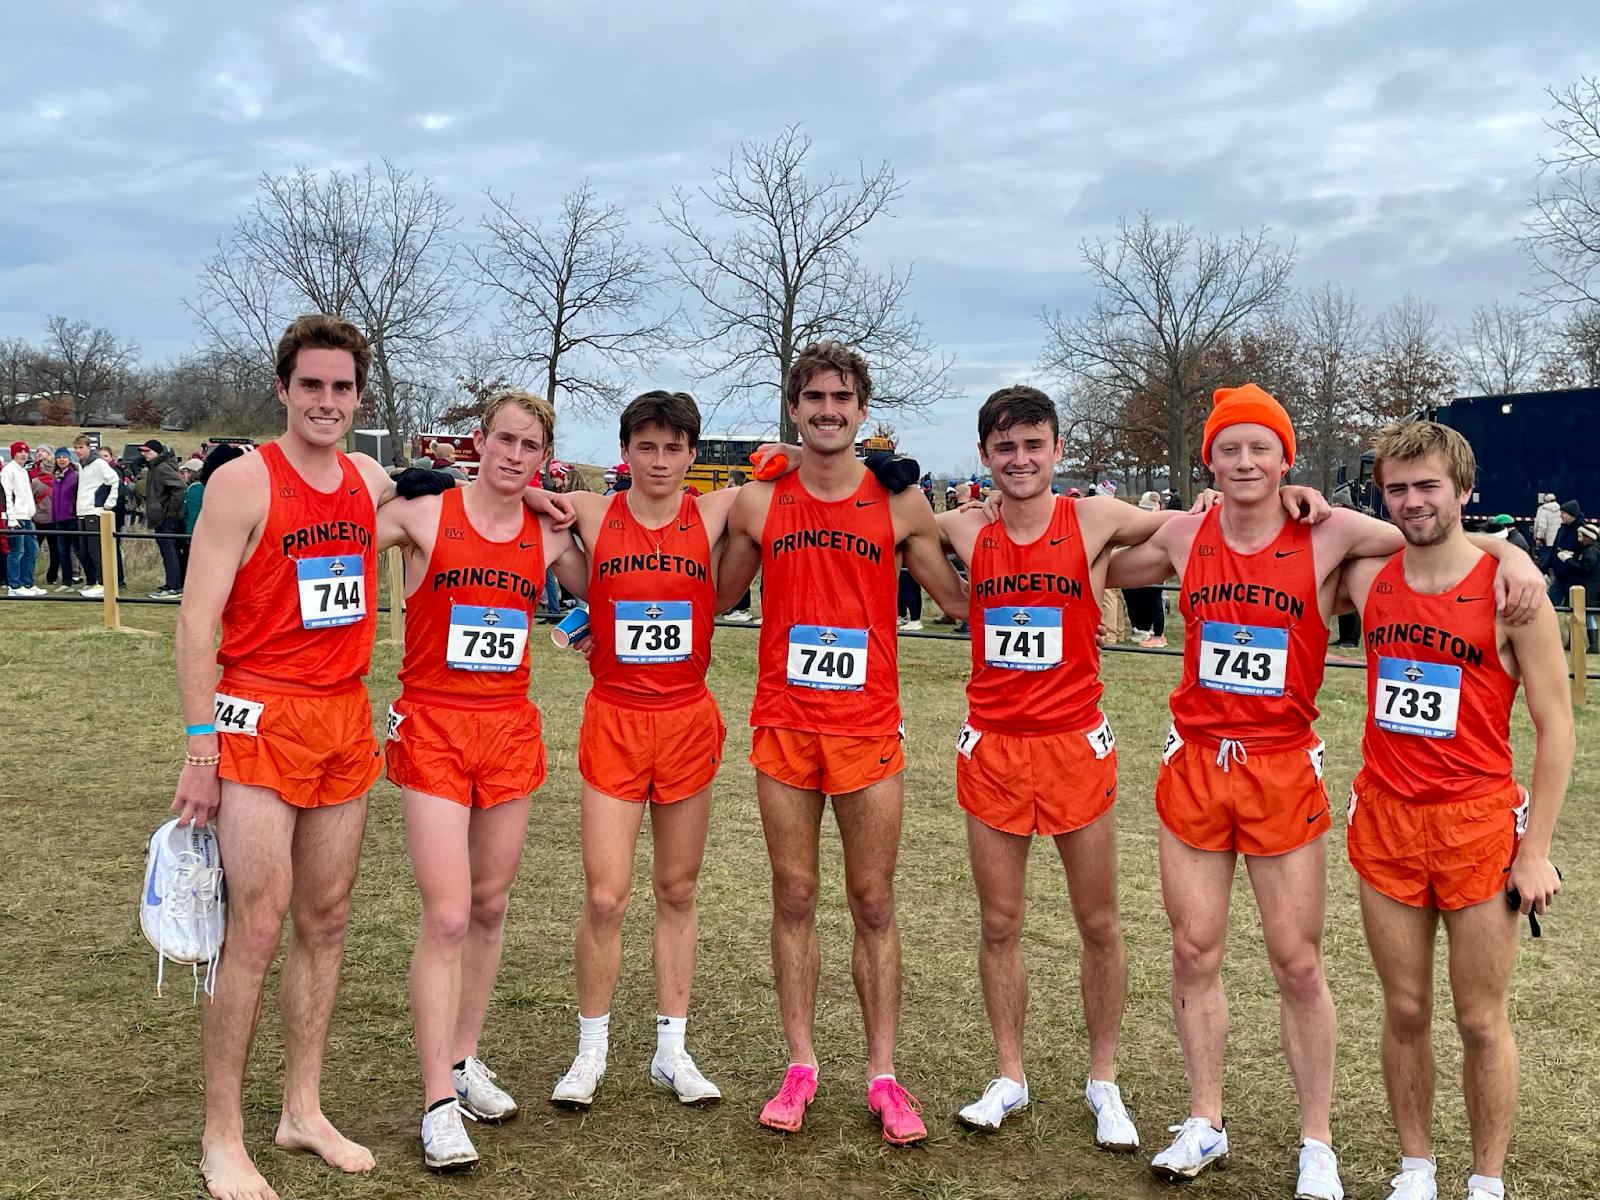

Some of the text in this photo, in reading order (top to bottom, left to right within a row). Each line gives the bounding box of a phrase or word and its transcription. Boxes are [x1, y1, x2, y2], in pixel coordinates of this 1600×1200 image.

[282, 521, 372, 556] PRINCETON
[773, 529, 882, 565] PRINCETON
[599, 554, 707, 584] PRINCETON
[314, 581, 360, 612] 744
[433, 567, 538, 603] PRINCETON
[975, 573, 1082, 604] PRINCETON
[1189, 583, 1305, 620] PRINCETON
[463, 630, 515, 659] 735
[627, 624, 681, 651] 738
[996, 630, 1045, 658] 741
[1368, 624, 1483, 666] PRINCETON
[801, 649, 855, 679] 740
[1213, 648, 1272, 681] 743
[215, 701, 250, 729] 744
[1385, 685, 1442, 721] 733
[1097, 724, 1114, 751] 74
